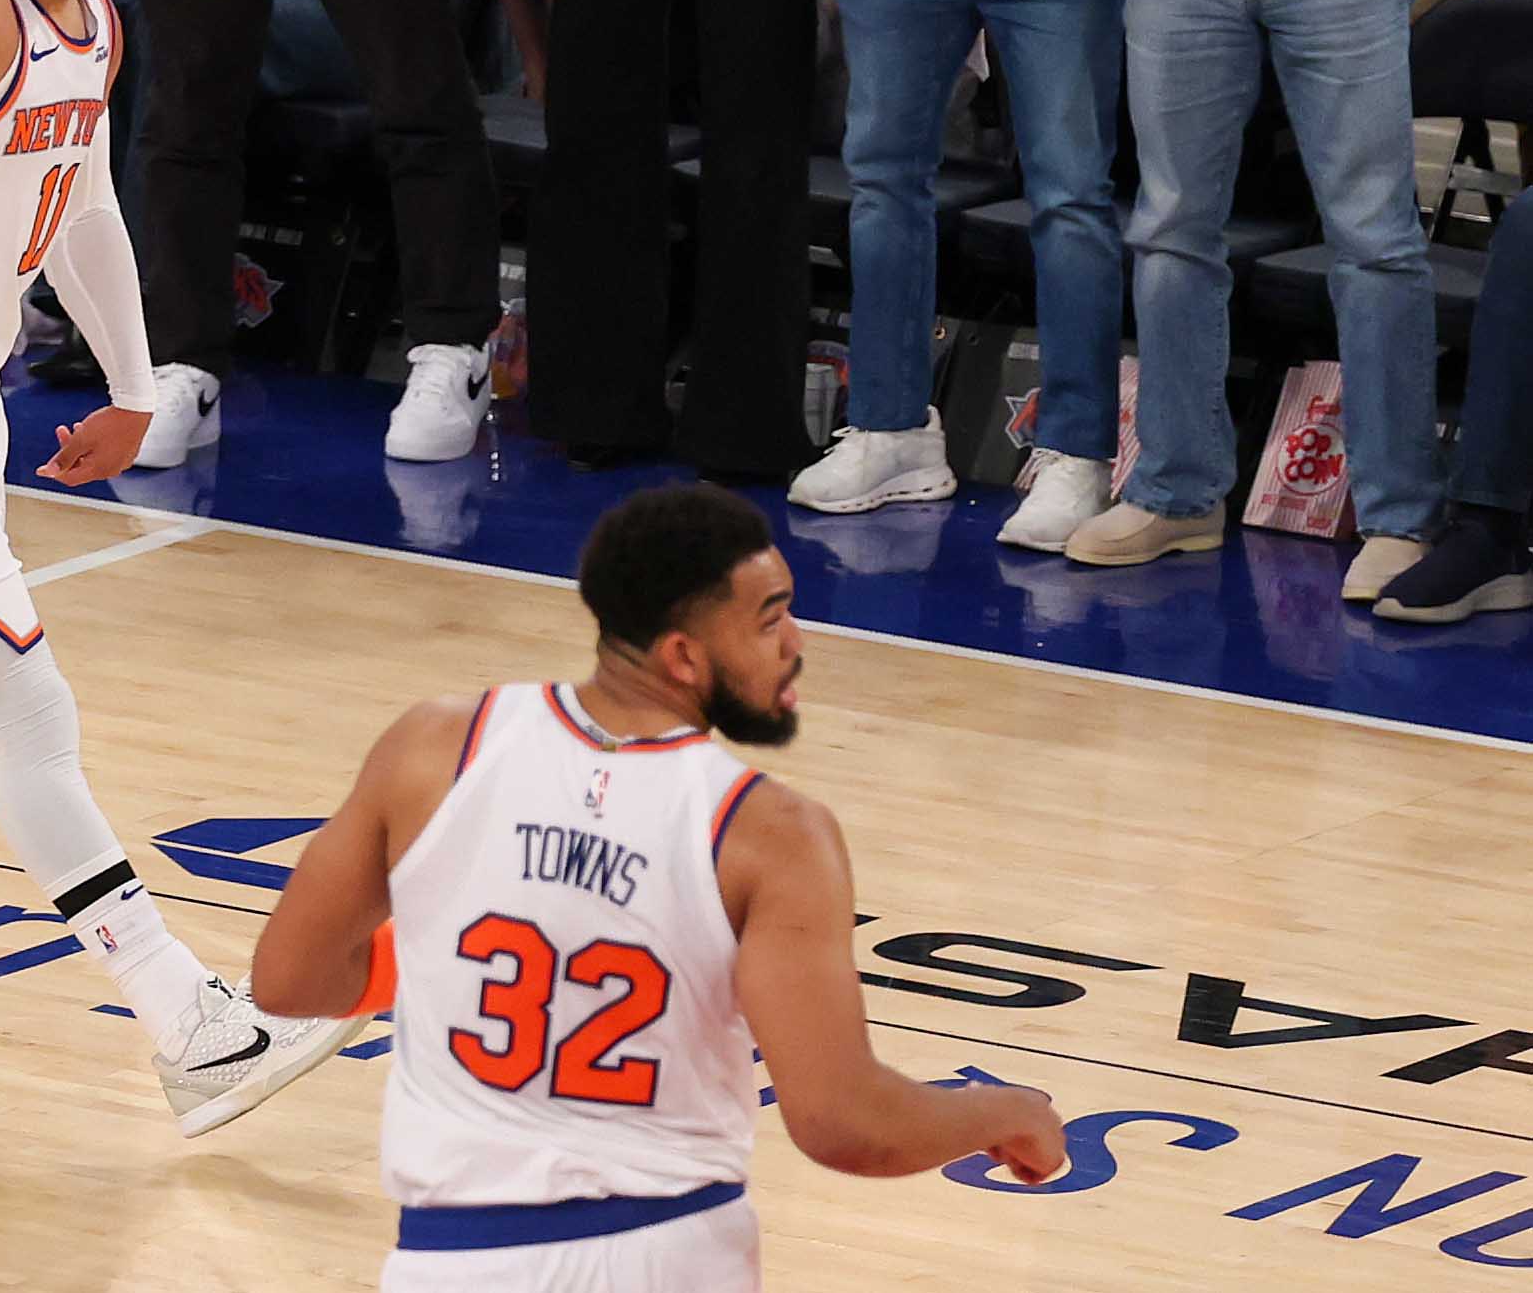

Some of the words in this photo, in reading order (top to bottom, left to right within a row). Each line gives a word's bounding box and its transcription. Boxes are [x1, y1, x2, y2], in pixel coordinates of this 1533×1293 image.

[3, 100, 76, 156] NEW
[17, 163, 81, 277] 11
[1286, 428, 1332, 458] POP
[515, 822, 648, 906] TOWNS
[448, 911, 672, 1108] 32
